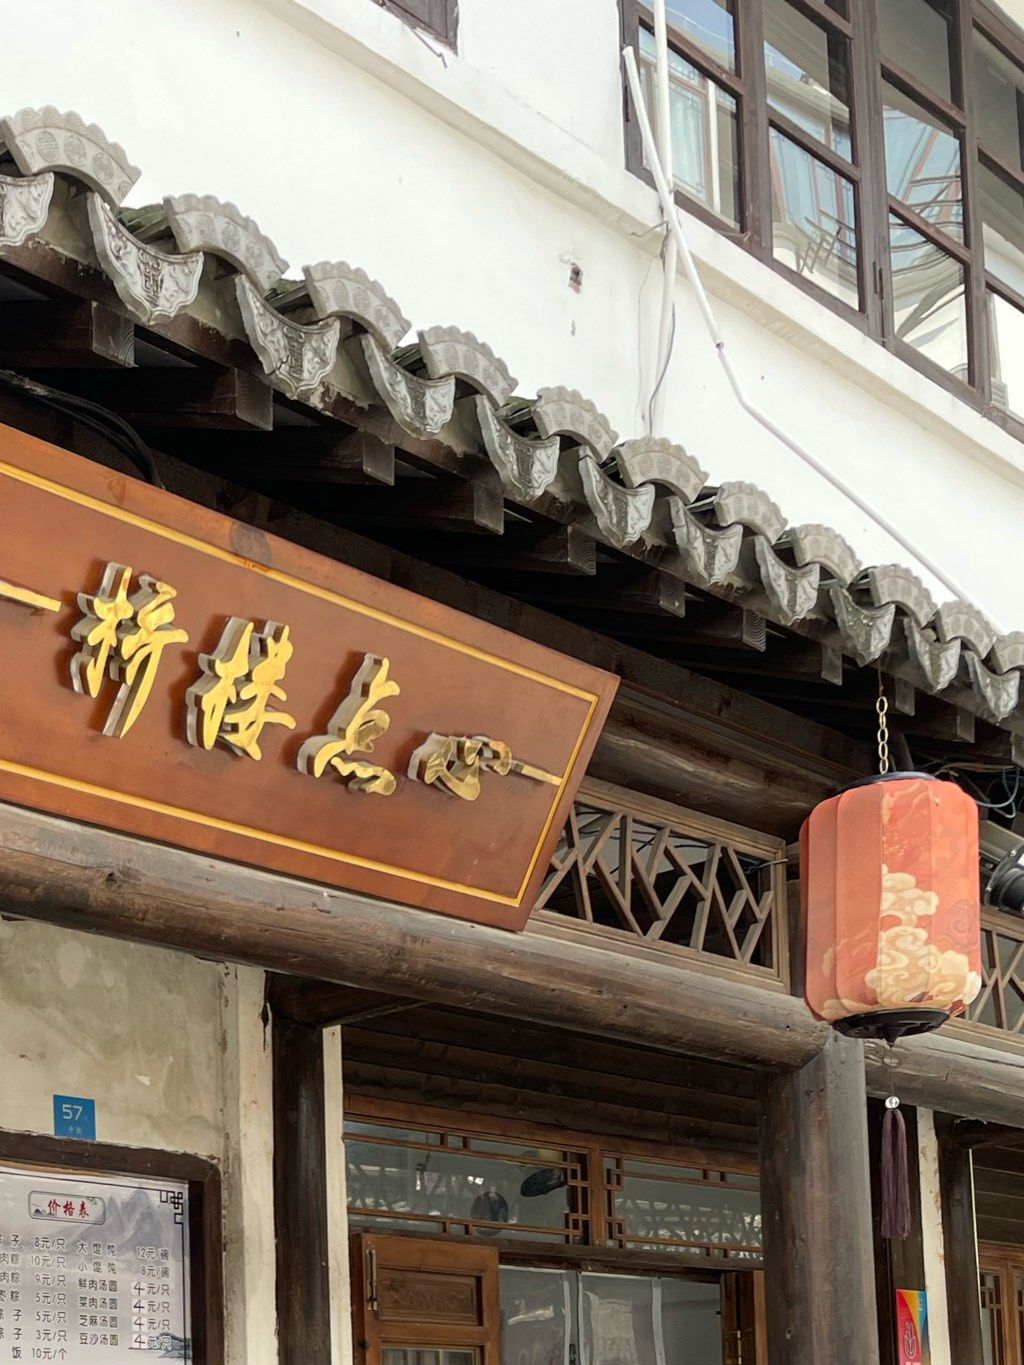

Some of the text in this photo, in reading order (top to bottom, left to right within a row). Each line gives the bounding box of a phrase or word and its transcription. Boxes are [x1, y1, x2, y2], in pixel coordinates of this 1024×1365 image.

[47, 1198, 90, 1218] 价格表
[34, 1236, 66, 1251] 8元/只
[31, 1255, 66, 1269] 10元/只
[35, 1274, 66, 1287] 9元/只
[35, 1292, 67, 1305] 5元/只
[35, 1310, 67, 1324] 5元/只
[35, 1329, 67, 1342] 3元/只
